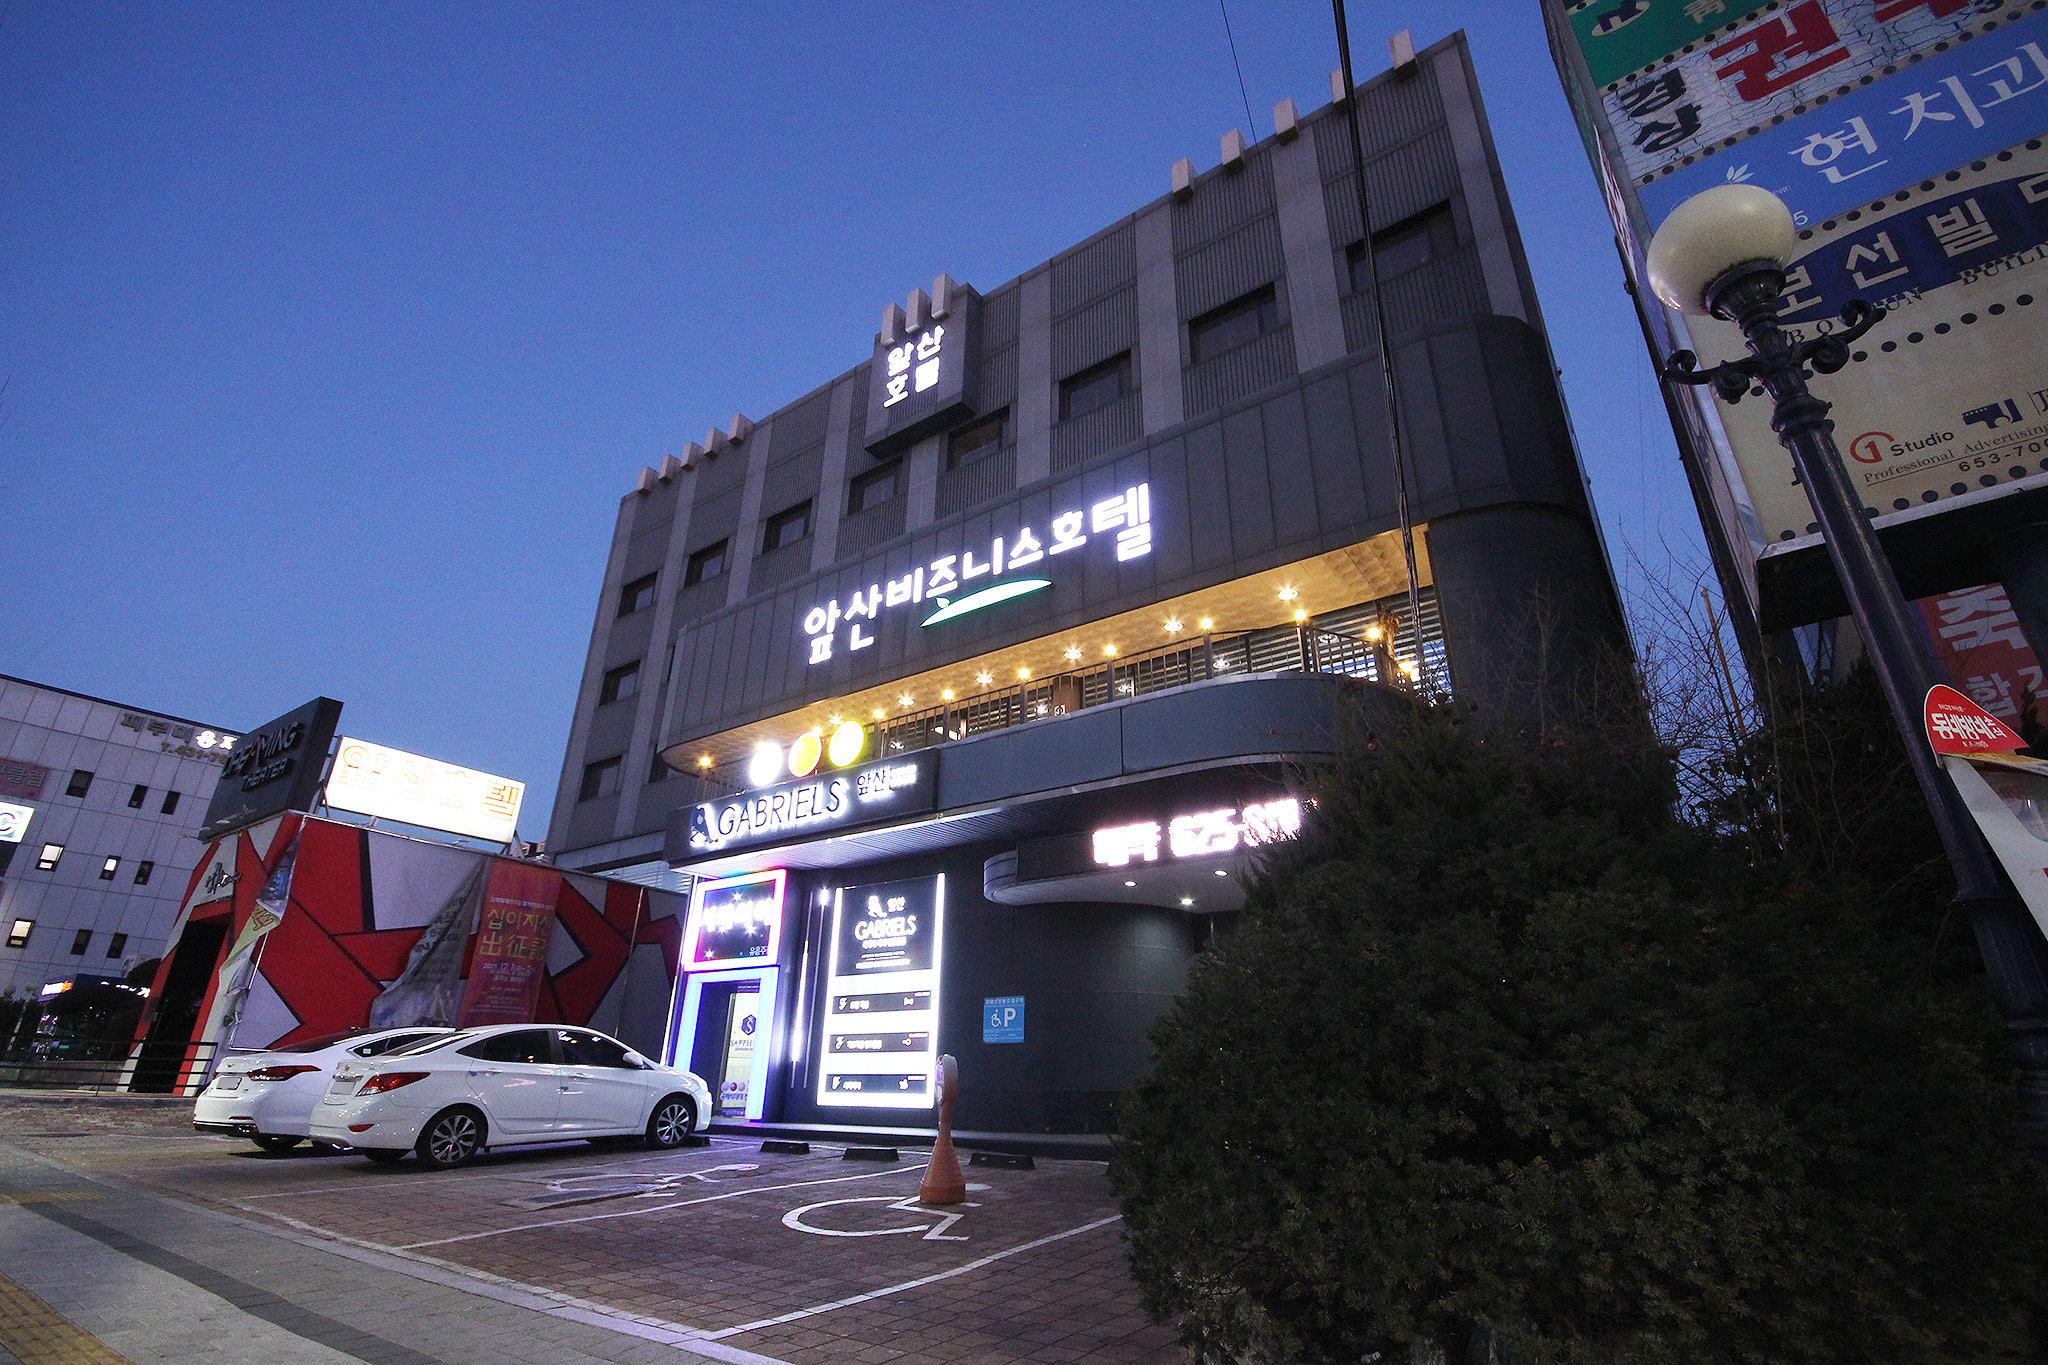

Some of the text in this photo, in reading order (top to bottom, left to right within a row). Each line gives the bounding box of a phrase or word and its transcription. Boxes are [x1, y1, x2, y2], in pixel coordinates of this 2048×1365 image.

[1890, 431, 1954, 457] Studio
[1863, 449, 1954, 483] Professional
[717, 780, 843, 836] GABRIELS
[1004, 1008, 1016, 1027] P
